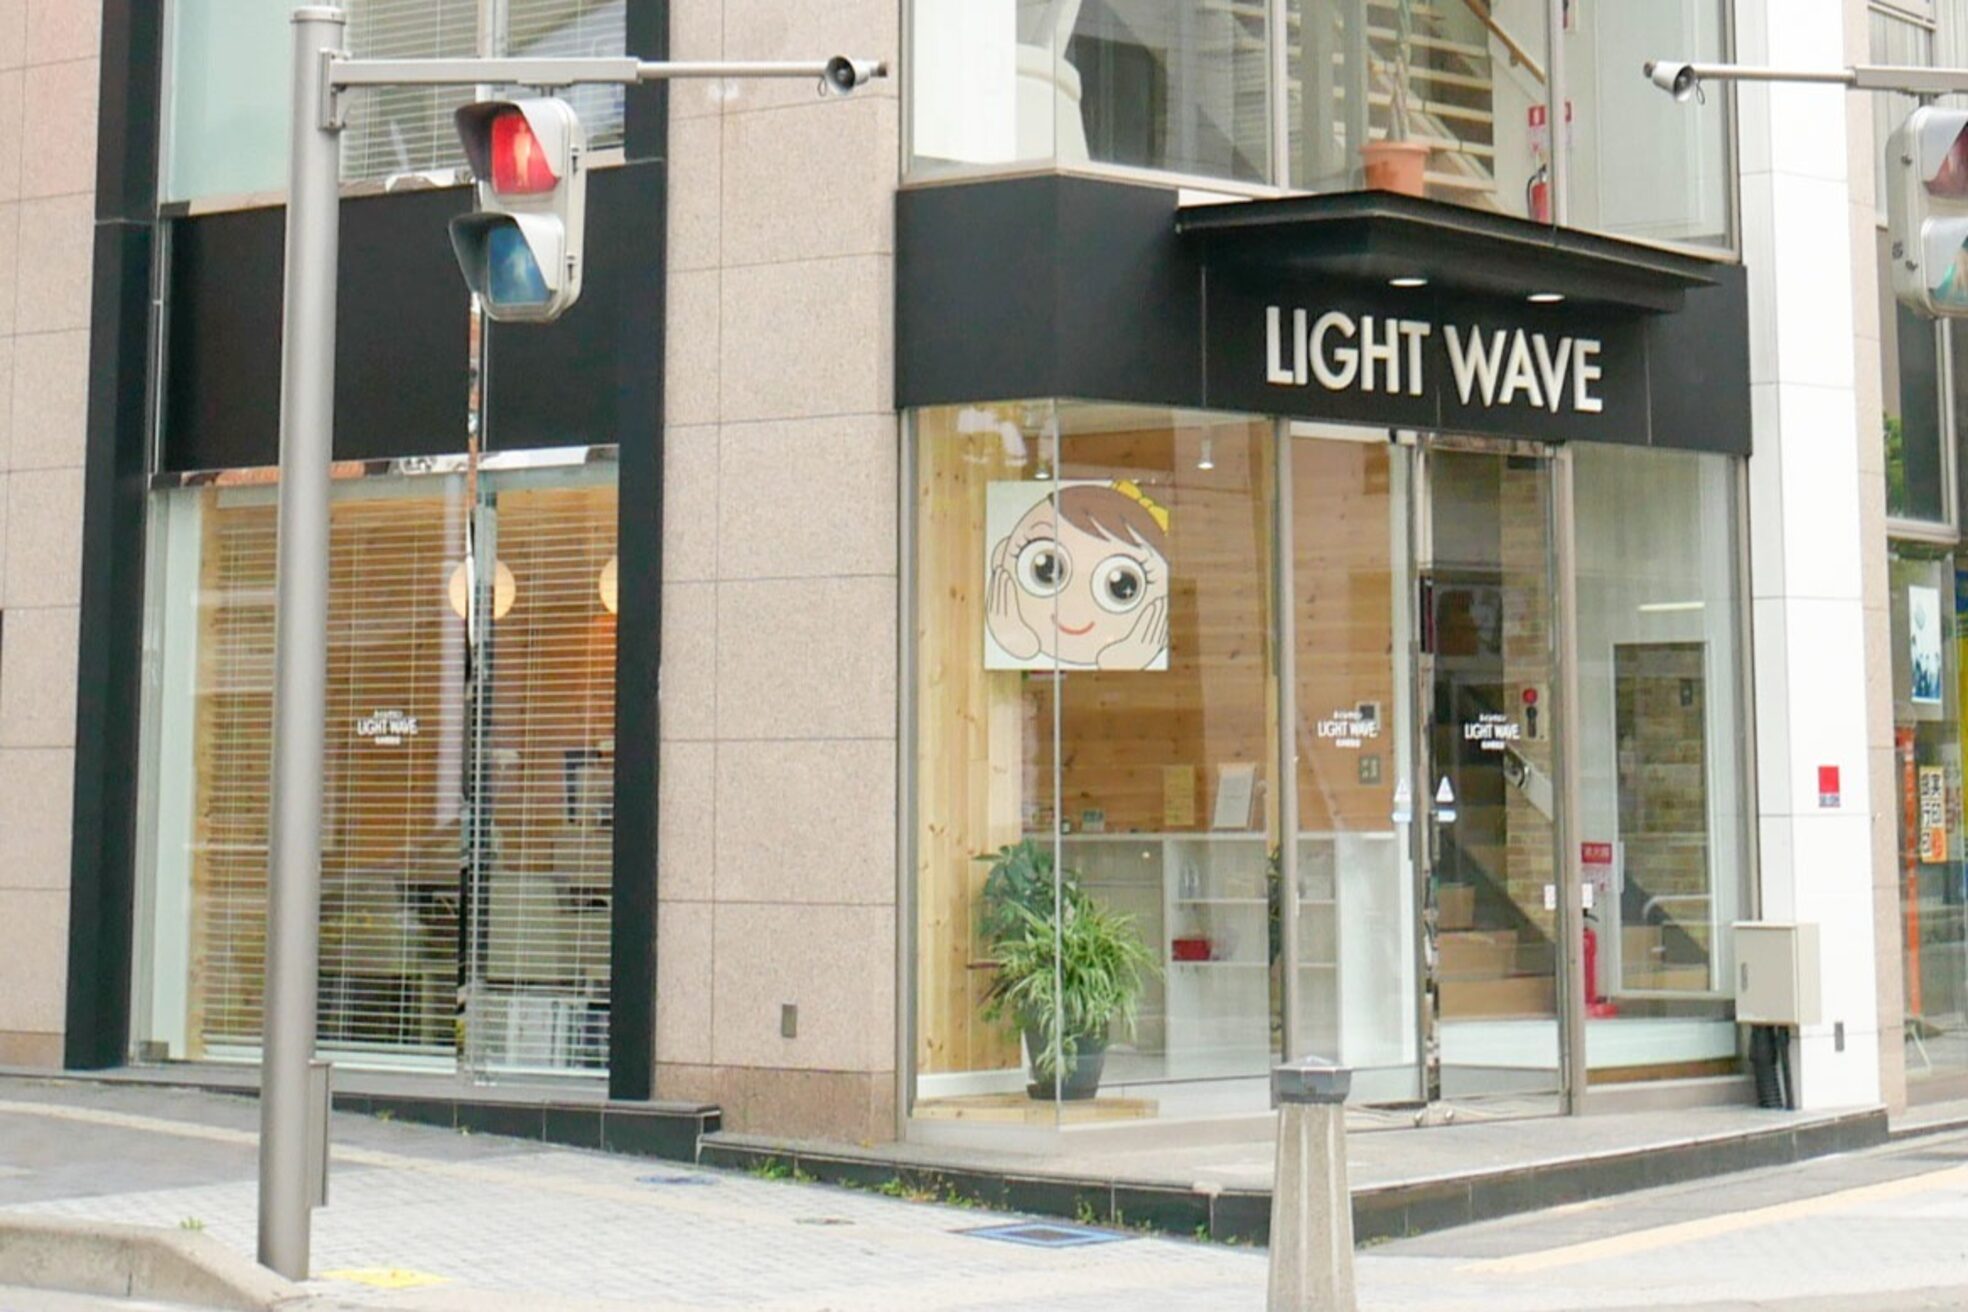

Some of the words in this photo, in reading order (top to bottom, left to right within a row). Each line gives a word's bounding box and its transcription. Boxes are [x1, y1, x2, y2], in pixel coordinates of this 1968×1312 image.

[1266, 305, 1432, 396] LIGHT
[1443, 323, 1603, 413] WAVE
[1317, 720, 1348, 738] LIGHT
[1349, 720, 1378, 738] WAVE
[1464, 722, 1493, 740] LIGHT
[1494, 723, 1521, 740] WAVE
